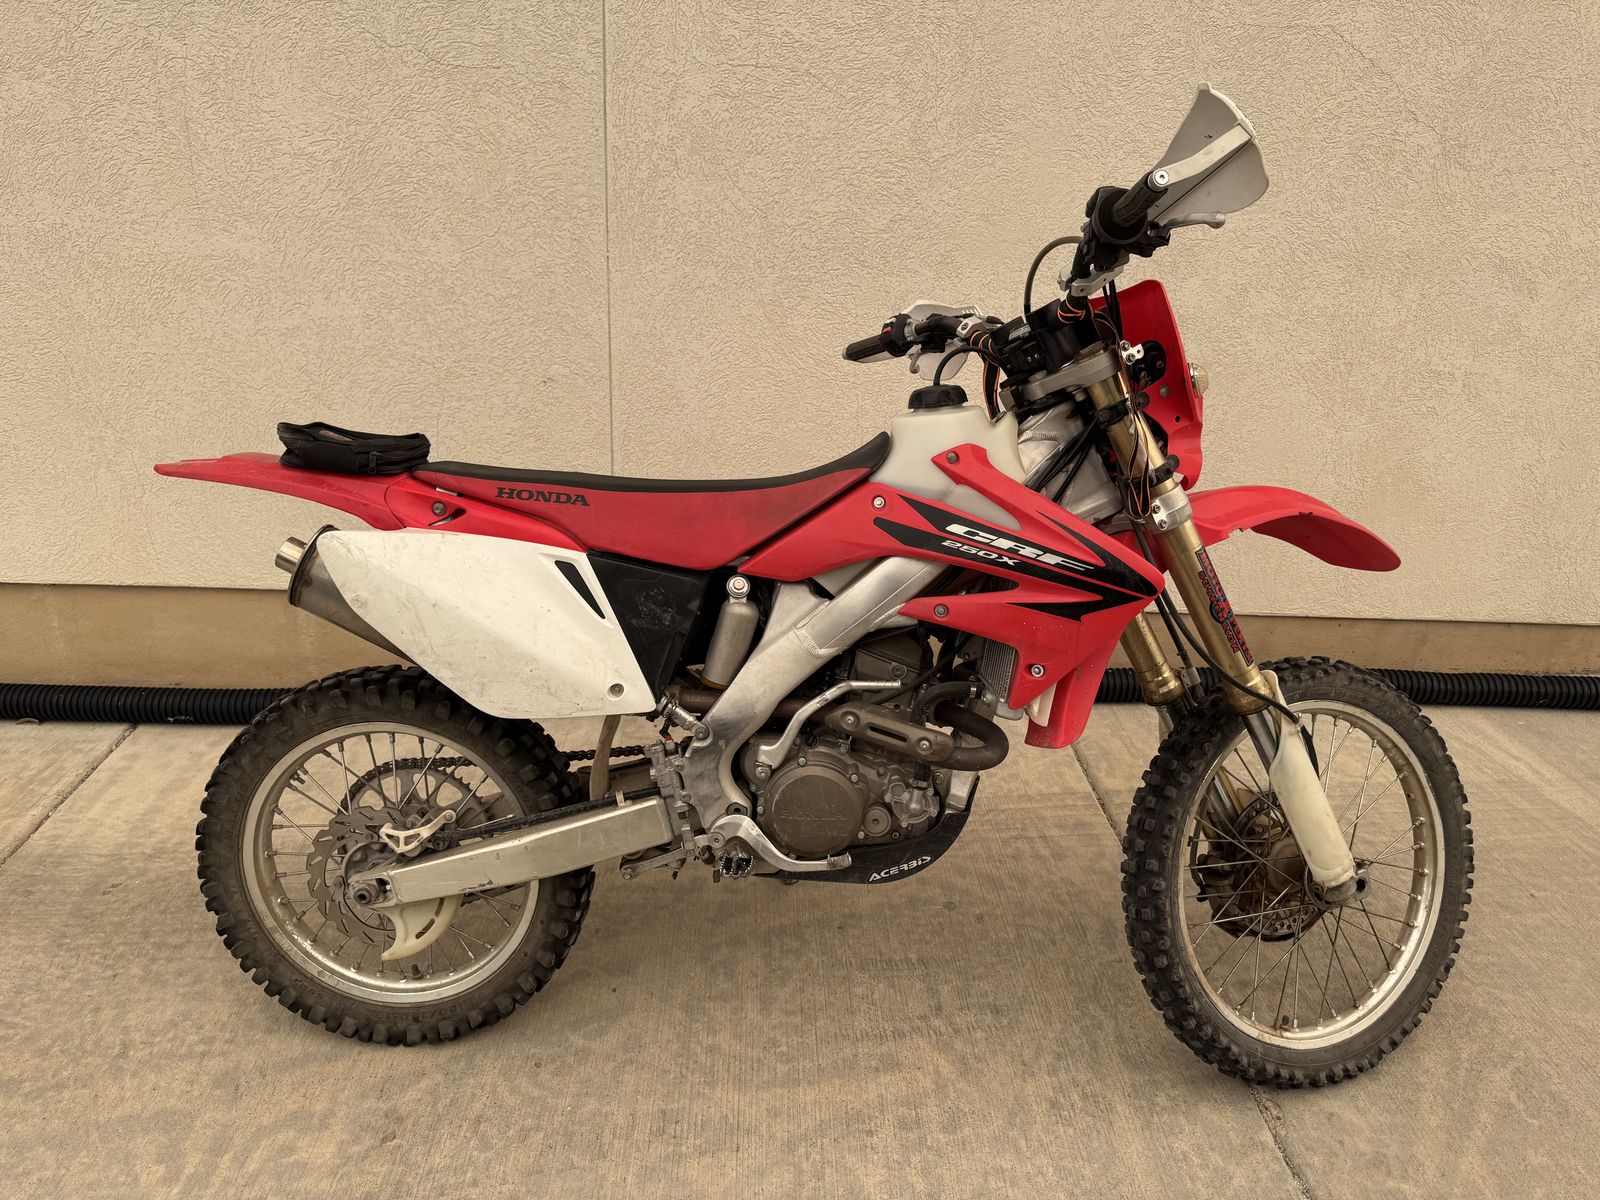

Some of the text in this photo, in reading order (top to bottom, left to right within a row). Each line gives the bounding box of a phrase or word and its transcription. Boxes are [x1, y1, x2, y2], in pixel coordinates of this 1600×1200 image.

[495, 487, 590, 506] HONDA
[941, 540, 1021, 566] 250X
[945, 523, 1095, 571] CRF
[868, 856, 932, 882] ACERBIS
